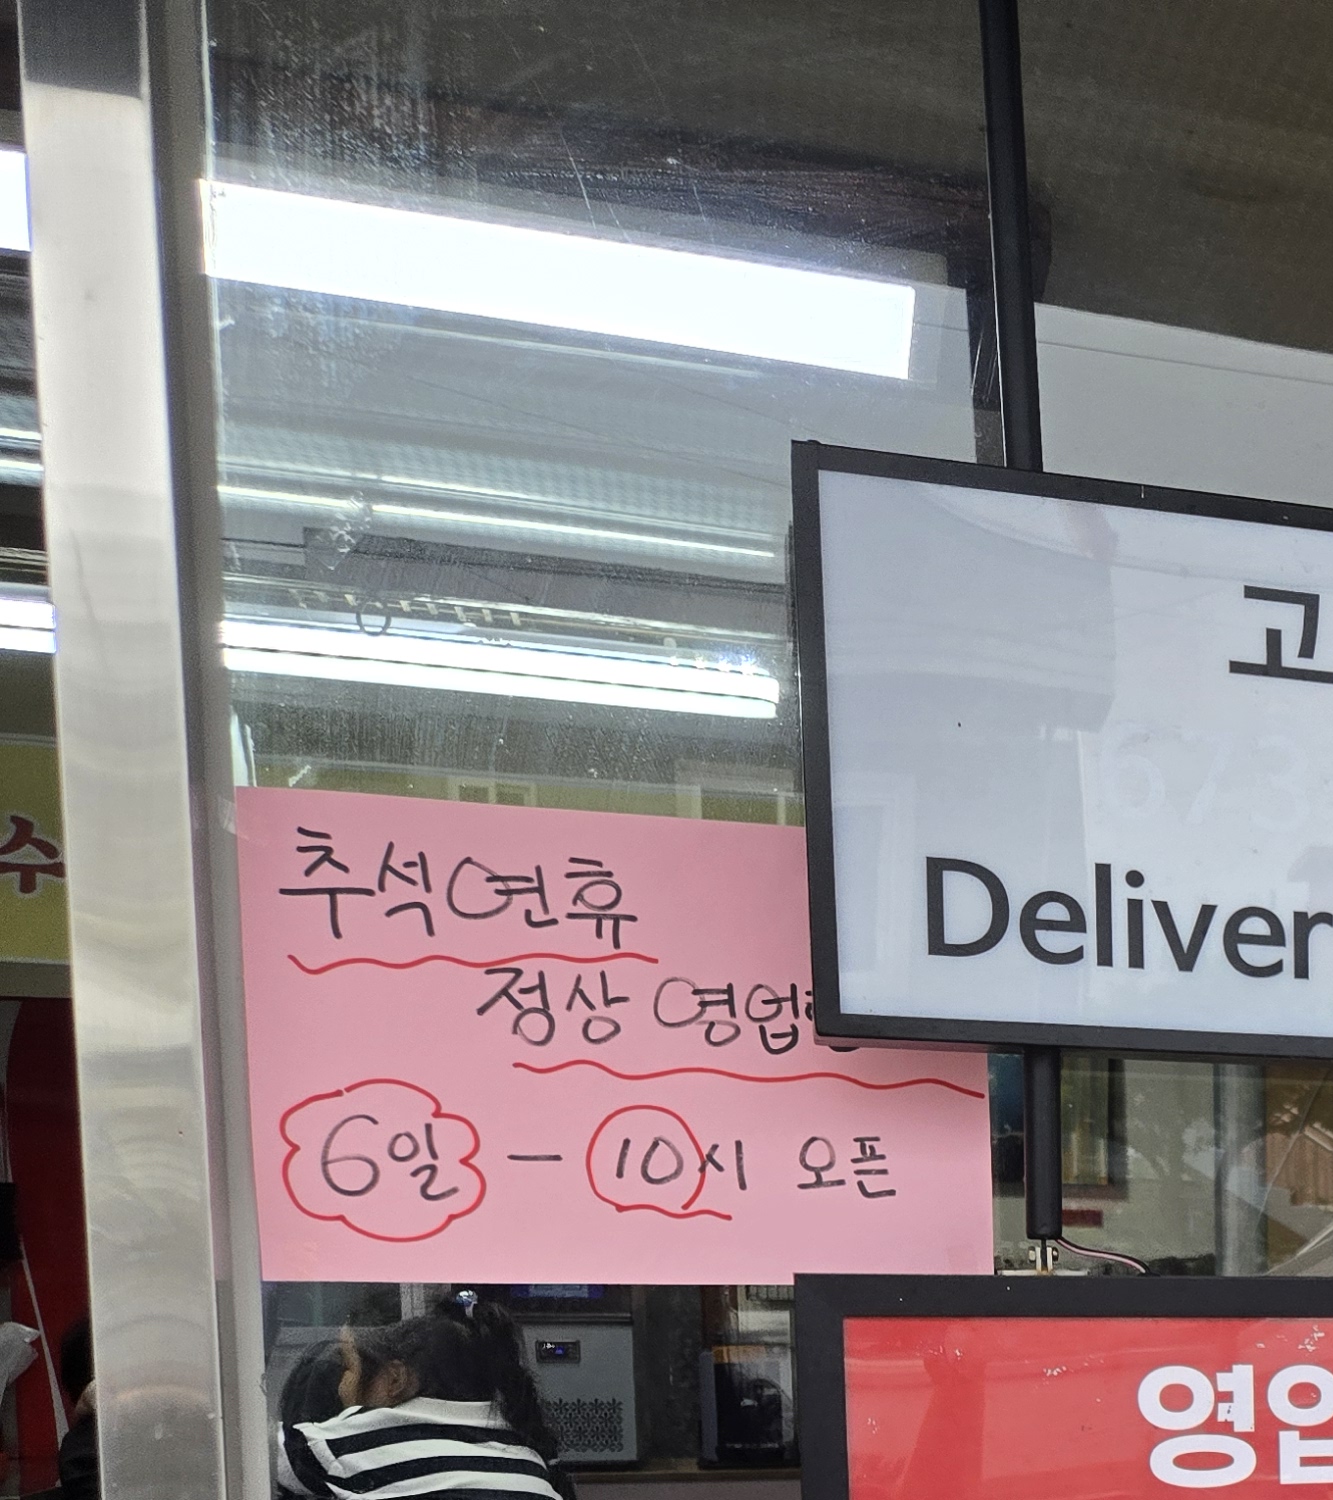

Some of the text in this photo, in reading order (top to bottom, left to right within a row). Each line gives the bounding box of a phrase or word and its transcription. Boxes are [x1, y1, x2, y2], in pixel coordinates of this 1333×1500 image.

[475, 966, 631, 1047] 정상
[321, 1114, 458, 1201] 6일
[614, 1136, 748, 1192] 10시
[797, 1135, 897, 1199] 오픈
